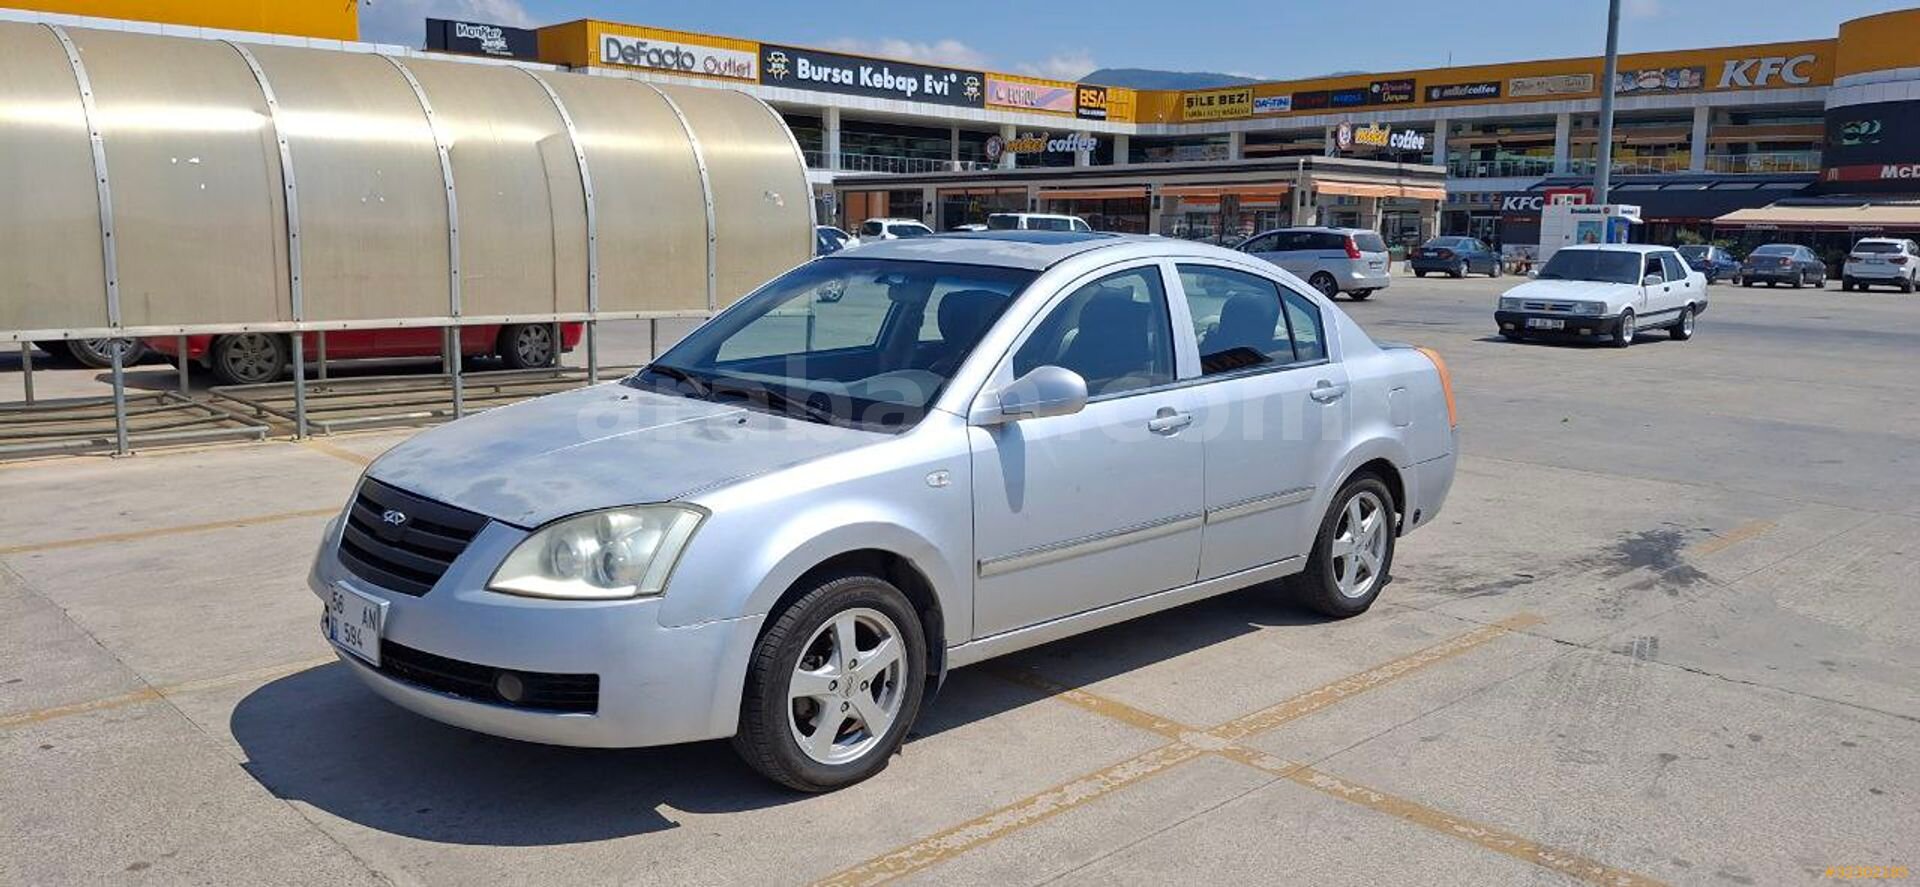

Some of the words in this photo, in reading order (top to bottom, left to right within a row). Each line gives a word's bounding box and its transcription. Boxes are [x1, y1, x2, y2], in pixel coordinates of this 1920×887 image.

[606, 37, 695, 70] DeFacto
[703, 55, 751, 77] Outlet
[796, 57, 854, 86] Bursa
[859, 66, 918, 97] Kebap
[1716, 54, 1816, 89] KFC
[1079, 88, 1106, 108] BSA
[1468, 83, 1497, 95] coffee
[1047, 132, 1097, 153] coffee
[1390, 129, 1425, 150] coffee
[1502, 196, 1544, 211] KFC
[361, 606, 377, 632] AN
[344, 621, 363, 649] 594
